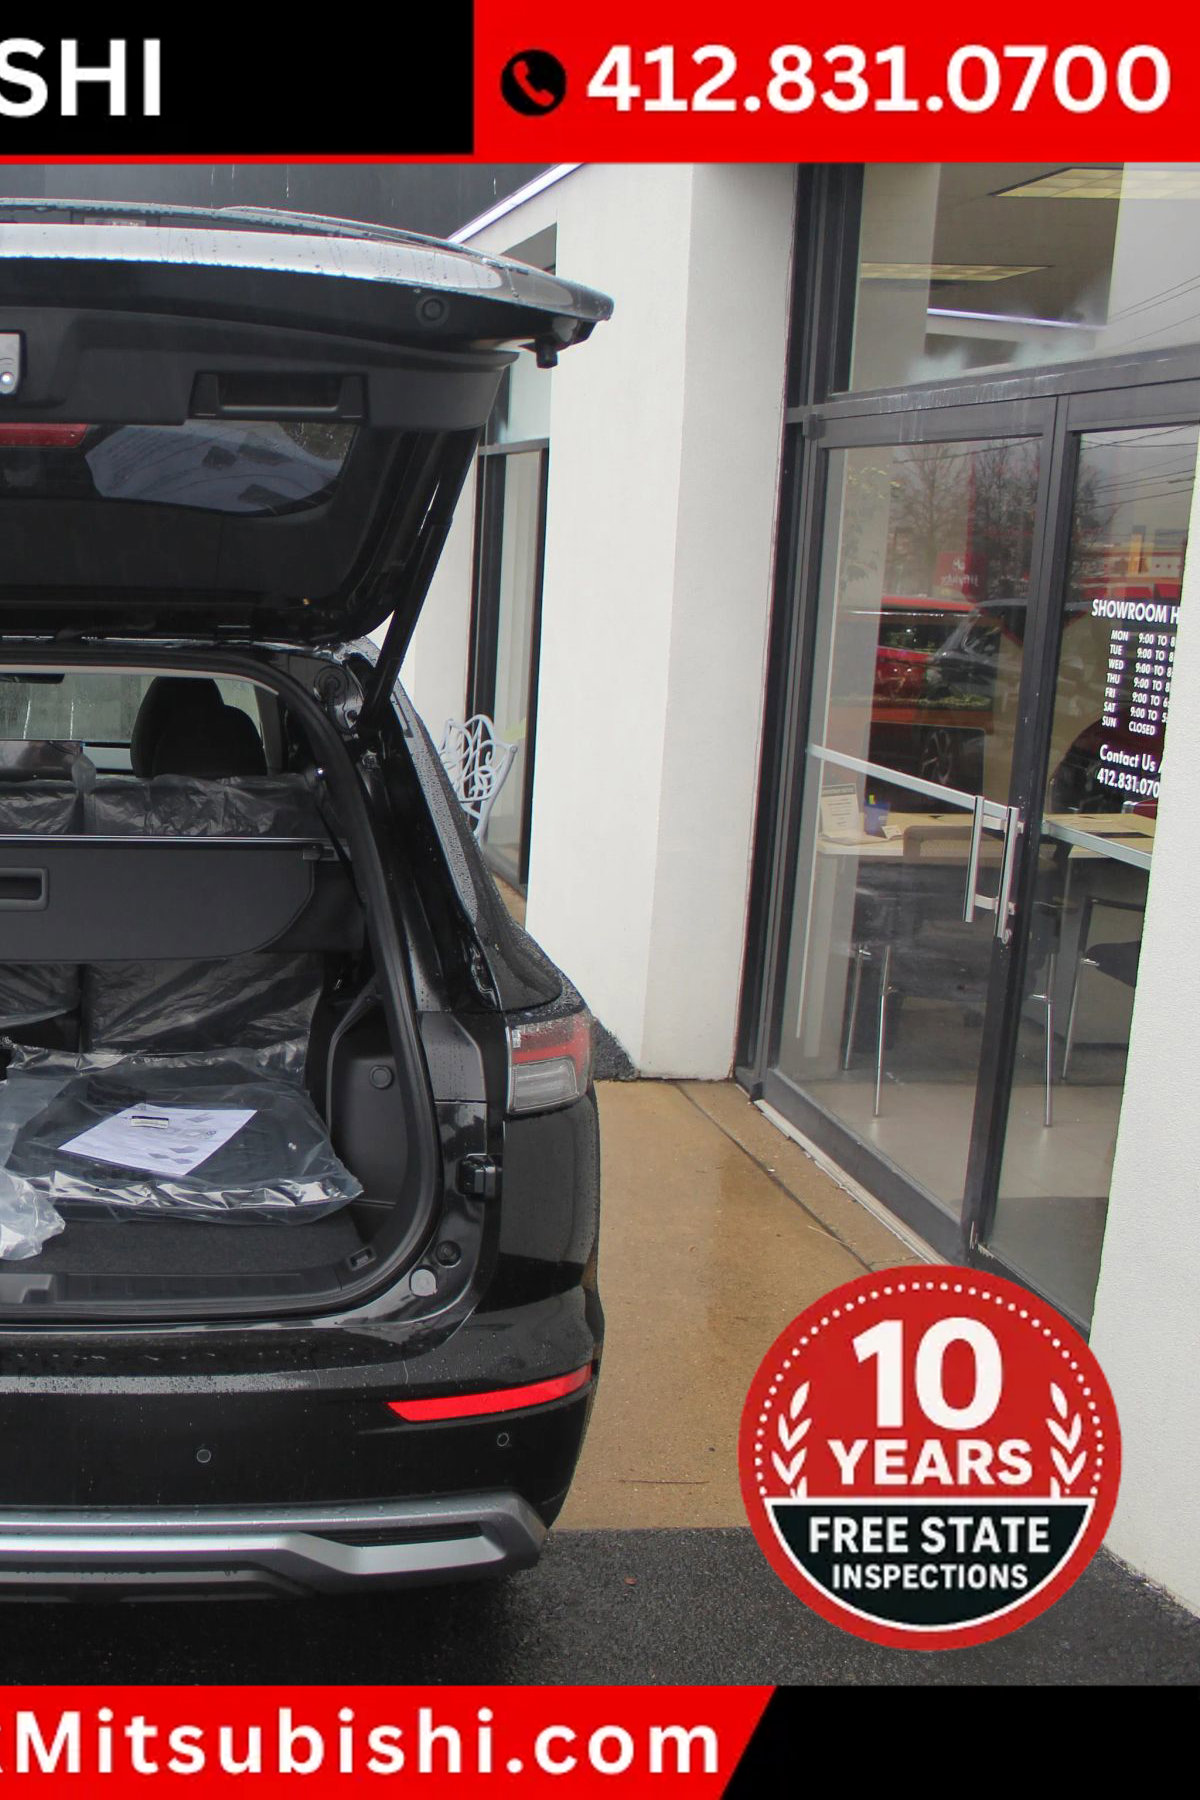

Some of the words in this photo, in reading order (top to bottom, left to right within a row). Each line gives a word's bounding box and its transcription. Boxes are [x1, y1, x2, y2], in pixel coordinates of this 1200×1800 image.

[1091, 599, 1167, 623] SHOWROOM
[1111, 630, 1129, 641] MON
[1139, 633, 1154, 645] 9:00
[1158, 635, 1167, 646] TO
[1110, 644, 1123, 655] TUE
[1137, 648, 1152, 659] 9:00
[1155, 650, 1165, 661] TO
[1108, 658, 1124, 670] WED
[1135, 662, 1151, 674] 9:00
[1154, 665, 1164, 676] TO
[1107, 673, 1120, 684] THU
[1134, 677, 1149, 689] 9:00
[1152, 680, 1162, 691] TO
[1105, 687, 1116, 698] FRI
[1132, 692, 1147, 703] 9:00
[1150, 695, 1160, 706] TO
[1104, 702, 1116, 712] SAT
[1130, 707, 1145, 718] 9:00
[1148, 710, 1158, 721] TO
[1102, 716, 1116, 728] SUN
[1128, 721, 1156, 735] CLOSED
[1100, 744, 1139, 768] Contact
[1141, 753, 1156, 772] Us
